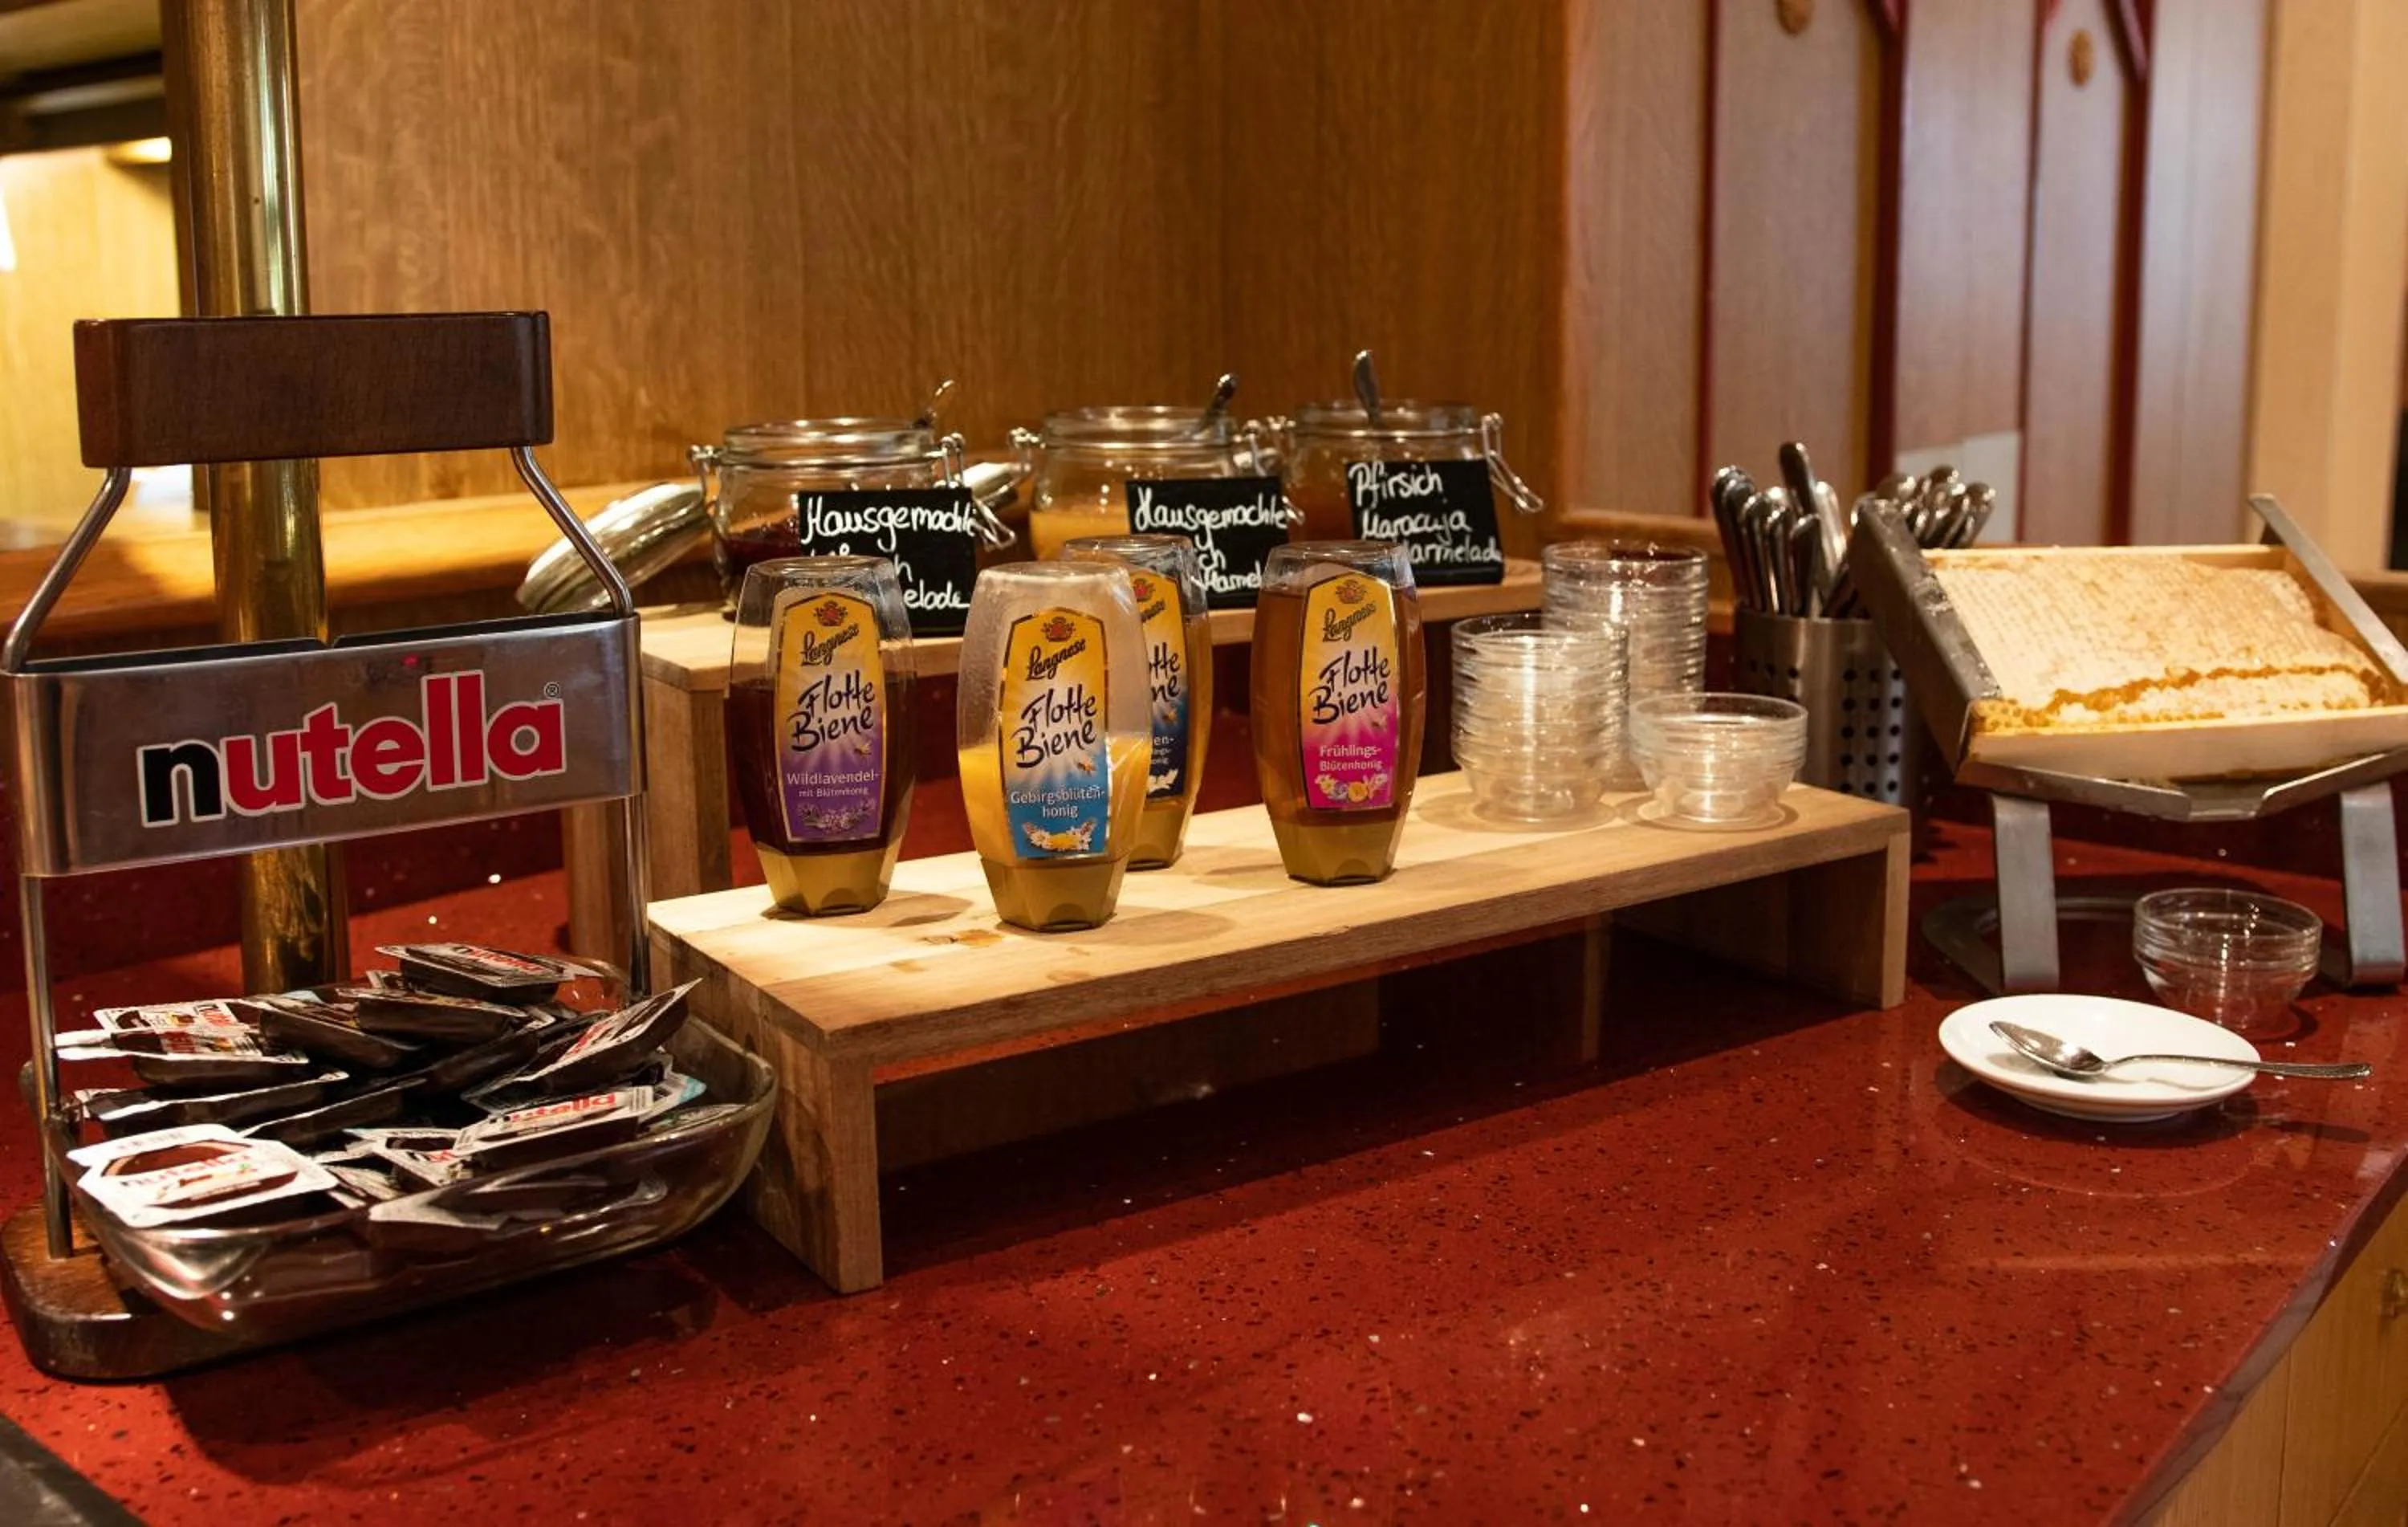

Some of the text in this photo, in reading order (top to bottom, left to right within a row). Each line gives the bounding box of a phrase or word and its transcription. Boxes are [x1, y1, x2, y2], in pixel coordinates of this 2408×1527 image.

[1348, 459, 1444, 508] Pfirsich
[1361, 498, 1473, 546] Maracuja
[800, 622, 860, 666] Langnese
[1323, 603, 1377, 642] Langnese
[1027, 638, 1086, 682] Langnese
[1318, 645, 1391, 692] Flotte
[798, 670, 876, 721] Flotte
[1022, 682, 1098, 732] Flotte
[1309, 679, 1389, 725] Biene
[137, 670, 567, 829] nutella
[787, 704, 875, 752] Biene
[1011, 720, 1097, 768] Biene
[1320, 745, 1382, 759] Frühlings-
[787, 768, 881, 785] Wildlavendel-
[1011, 786, 1106, 805] Gebirgsblüten-
[1043, 804, 1079, 820] honig
